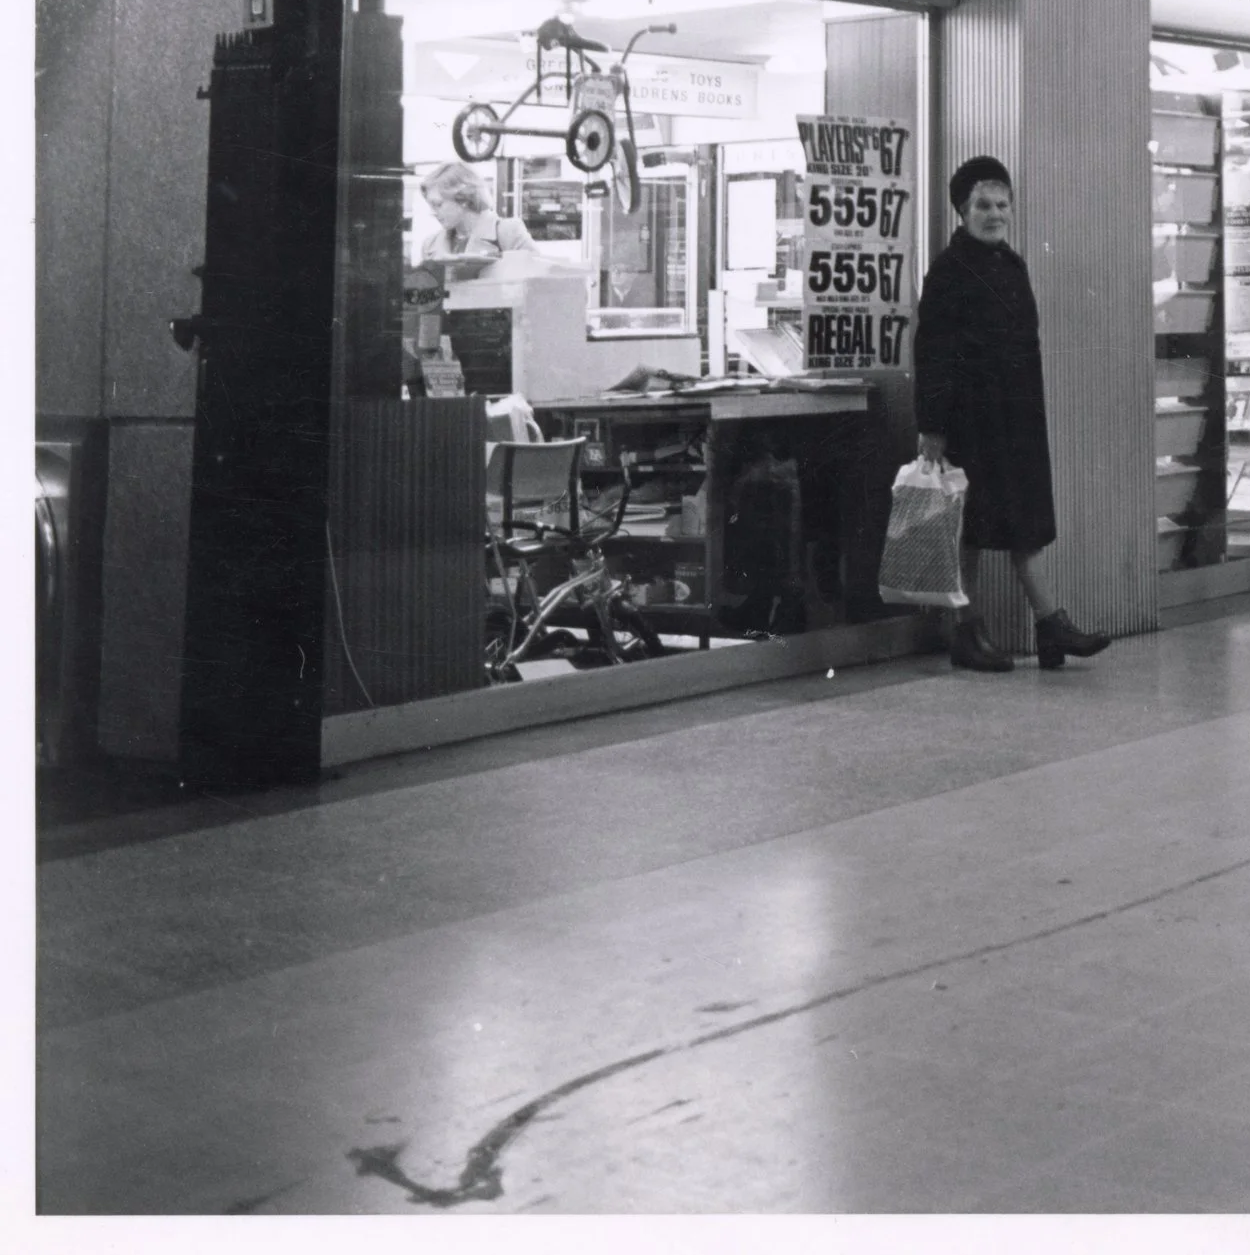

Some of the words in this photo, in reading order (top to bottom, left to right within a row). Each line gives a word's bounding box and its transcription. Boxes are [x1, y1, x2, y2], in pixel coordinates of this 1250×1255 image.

[632, 84, 689, 103] LDRENS
[698, 91, 743, 106] BOOKS
[690, 73, 723, 88] TOYS
[809, 184, 878, 228] 555
[808, 250, 878, 294] 555
[808, 314, 876, 355] REGAL
